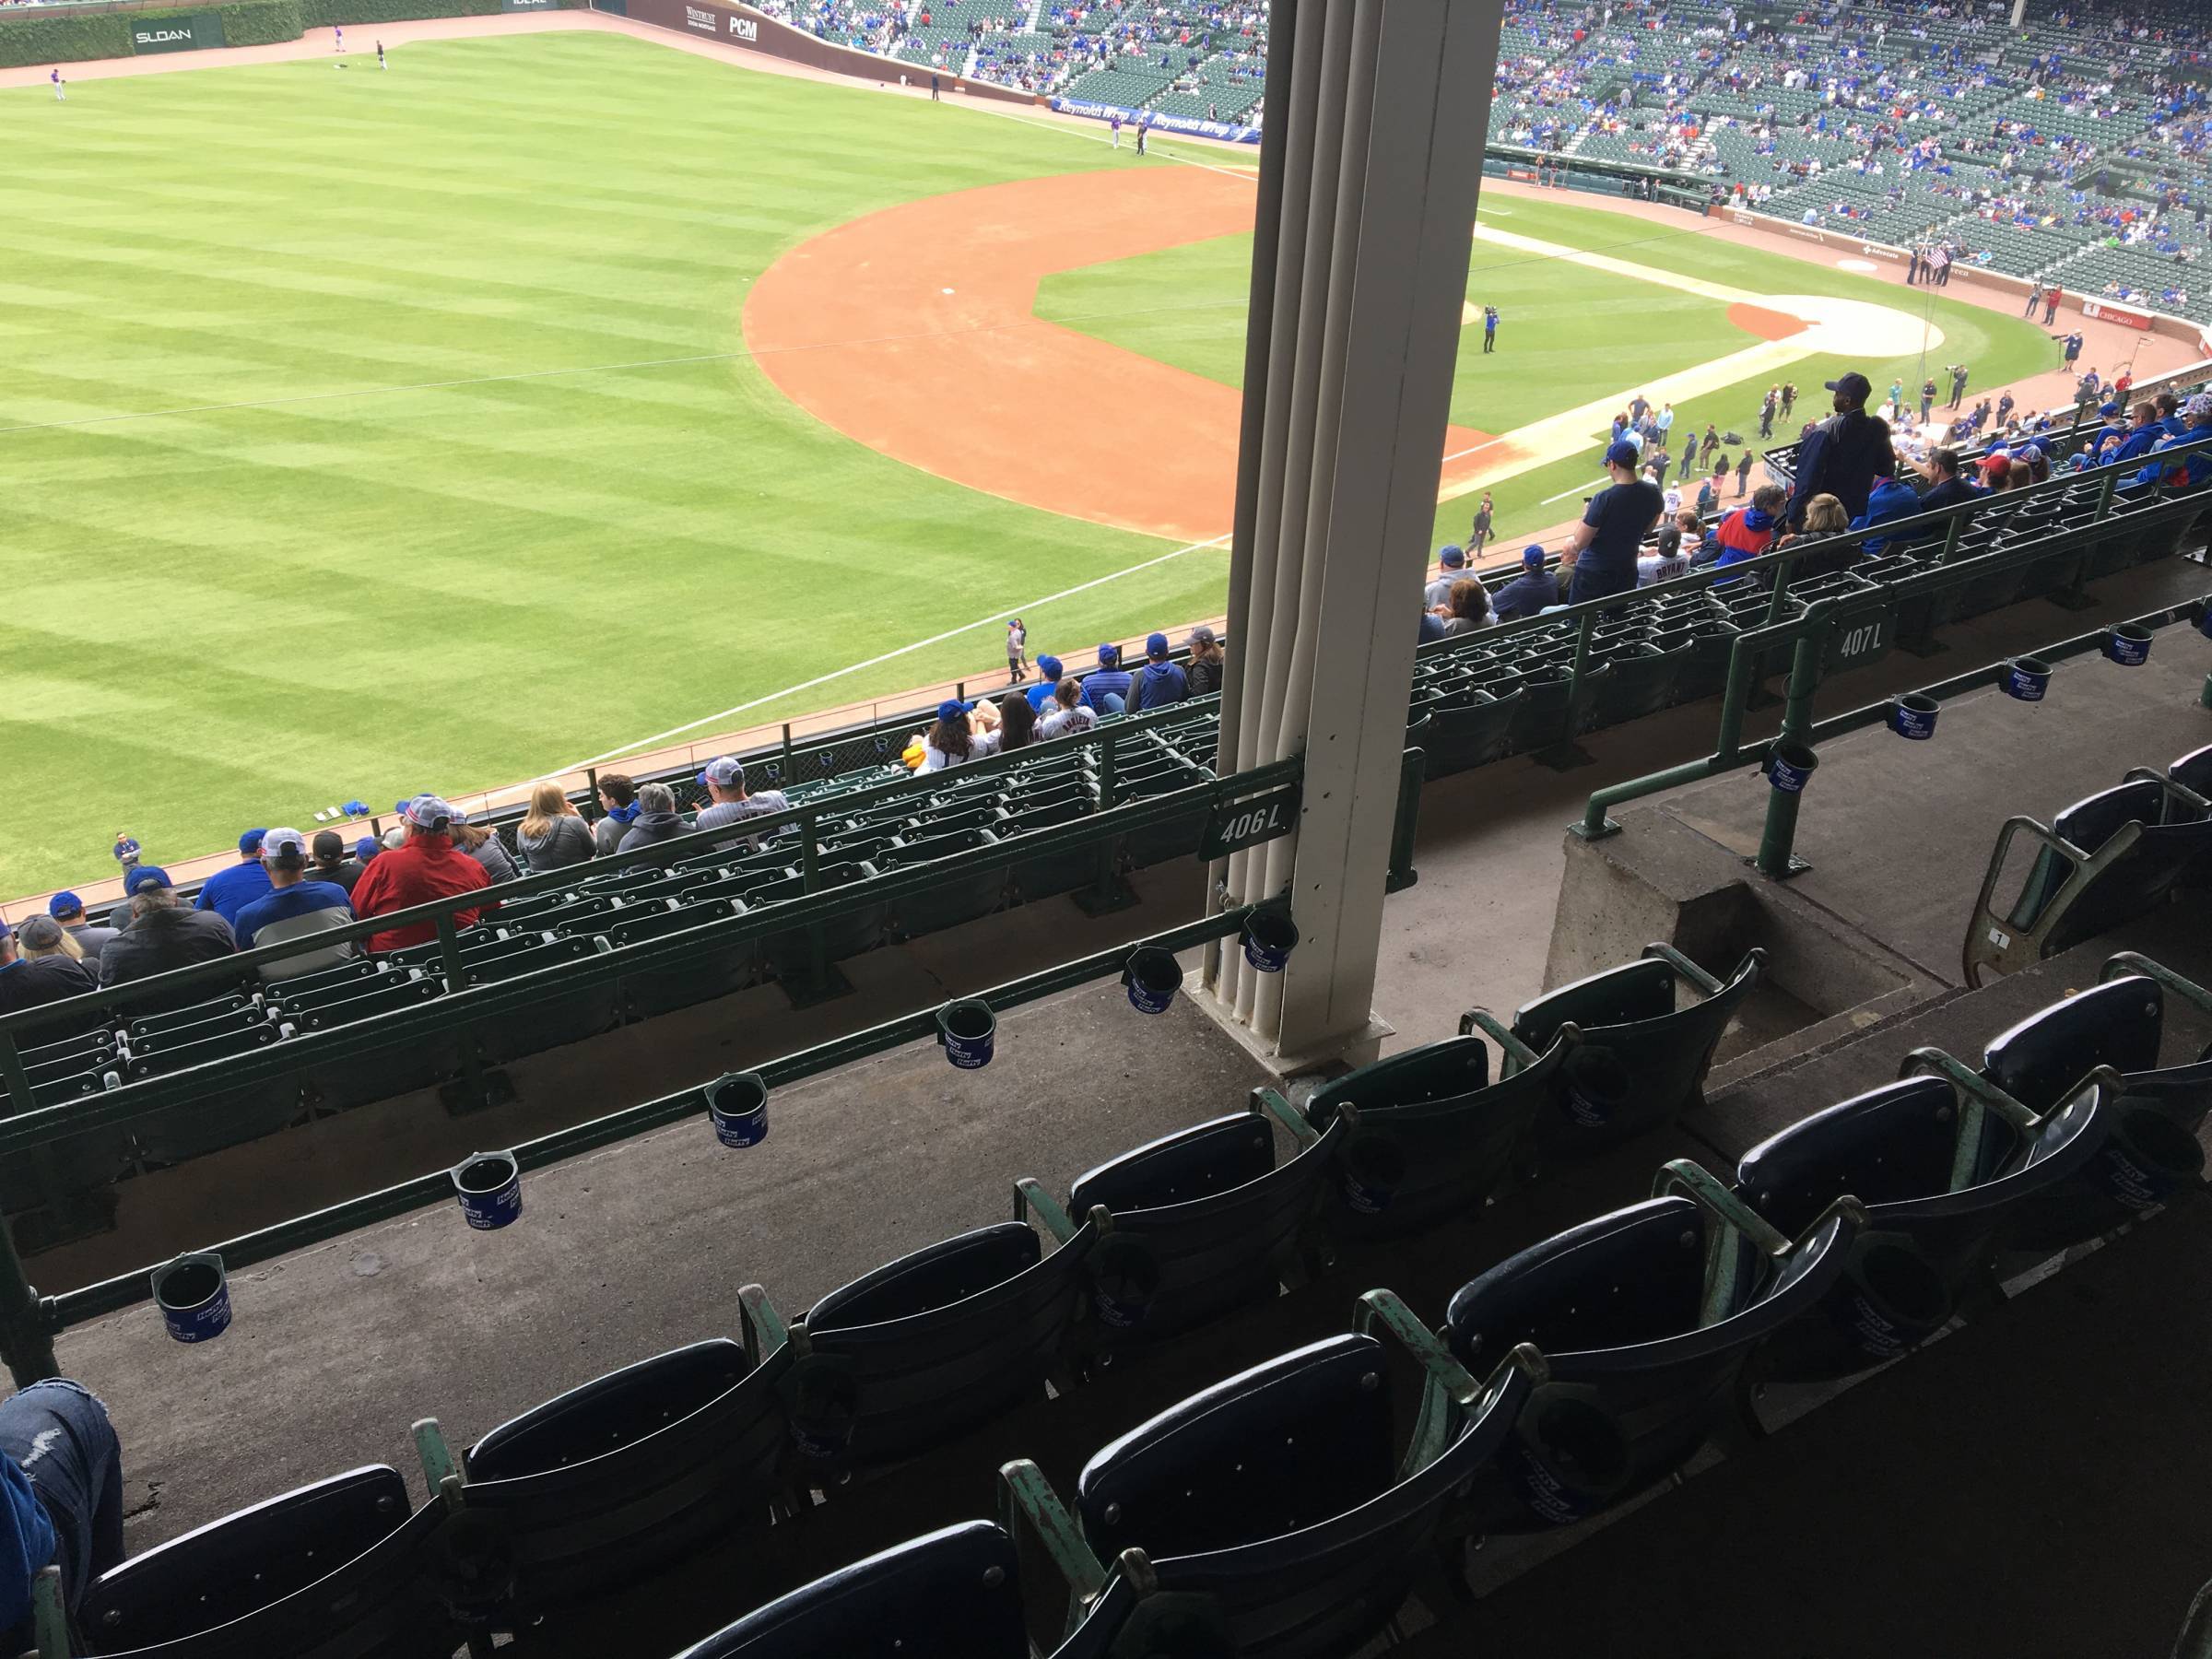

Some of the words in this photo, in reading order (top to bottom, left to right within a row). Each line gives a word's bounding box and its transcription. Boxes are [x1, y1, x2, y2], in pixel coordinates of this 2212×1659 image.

[135, 29, 191, 42] SLOAN
[729, 16, 757, 38] PCM
[1059, 100, 1103, 118] Reynolds
[1103, 105, 1129, 122] Wrap
[1152, 112, 1200, 131] Reynolds
[1199, 121, 1230, 137] Wrap
[1871, 248, 1900, 259] Advocate
[2100, 312, 2133, 325] CHICAGO
[1656, 561, 1685, 579] BRYANT
